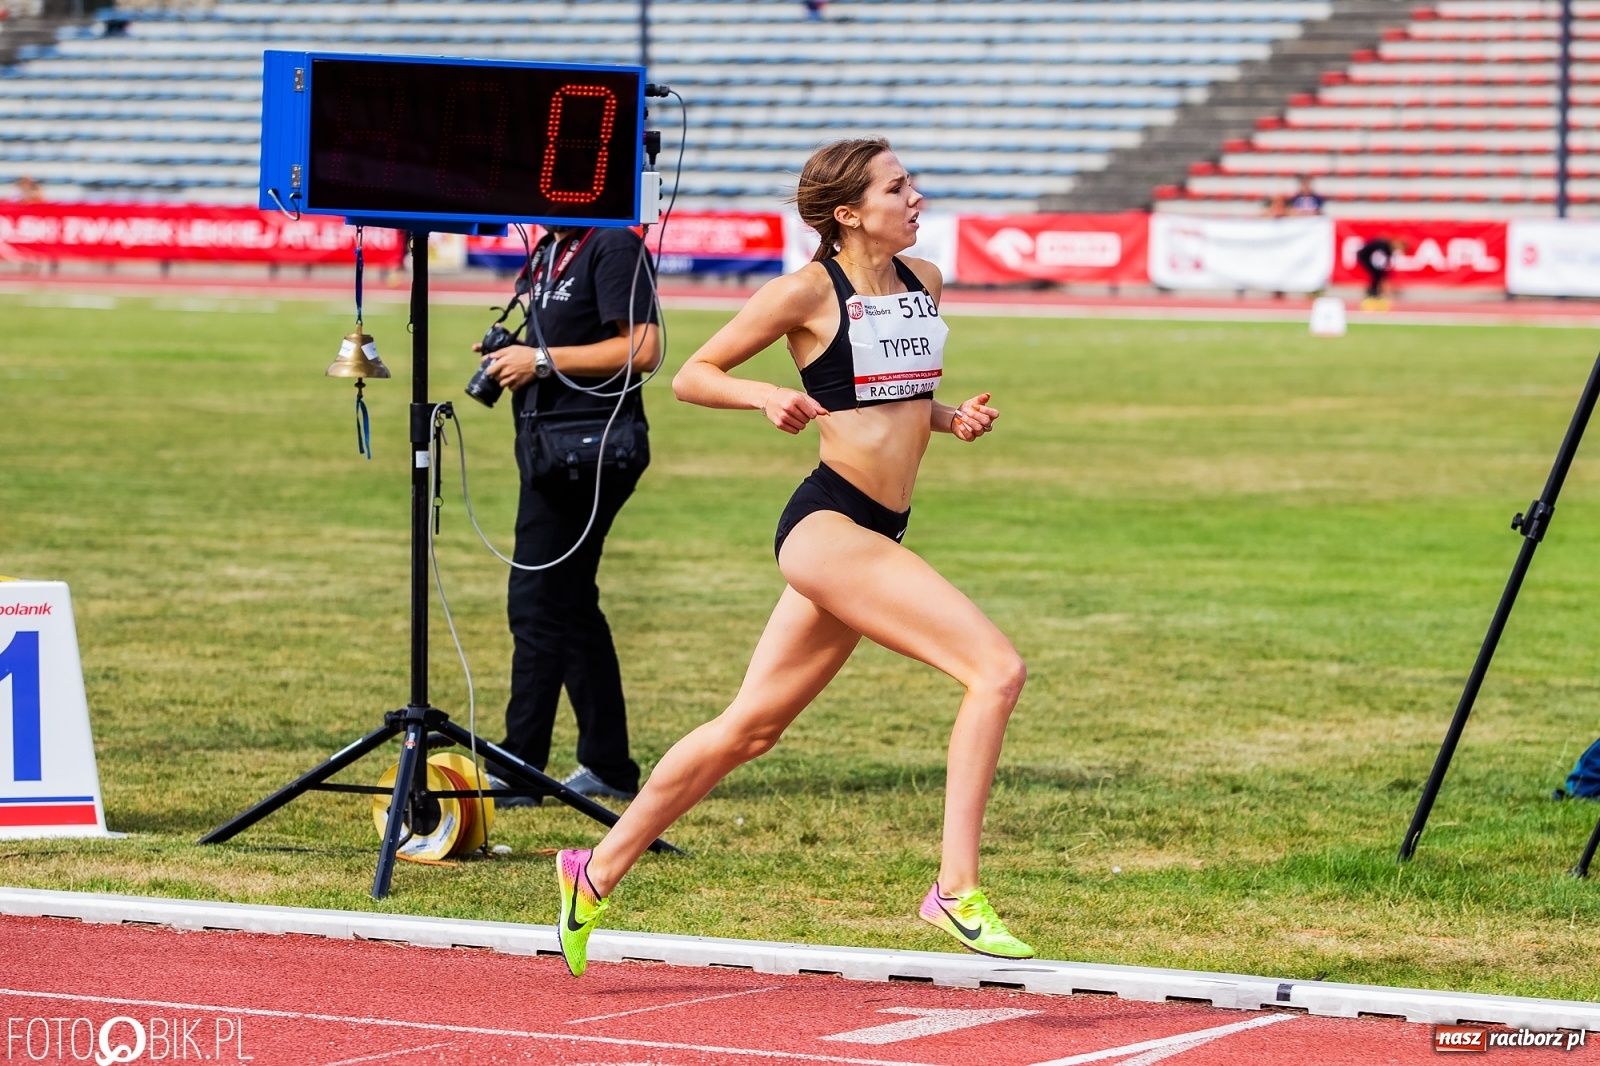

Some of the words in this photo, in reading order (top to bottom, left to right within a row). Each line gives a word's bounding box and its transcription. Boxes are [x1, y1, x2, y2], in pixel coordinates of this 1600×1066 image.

[540, 84, 617, 203] 0
[898, 296, 938, 319] 518
[879, 336, 931, 358] TYPER
[870, 381, 918, 397] RACIBÓRZ
[0, 630, 42, 781] 1
